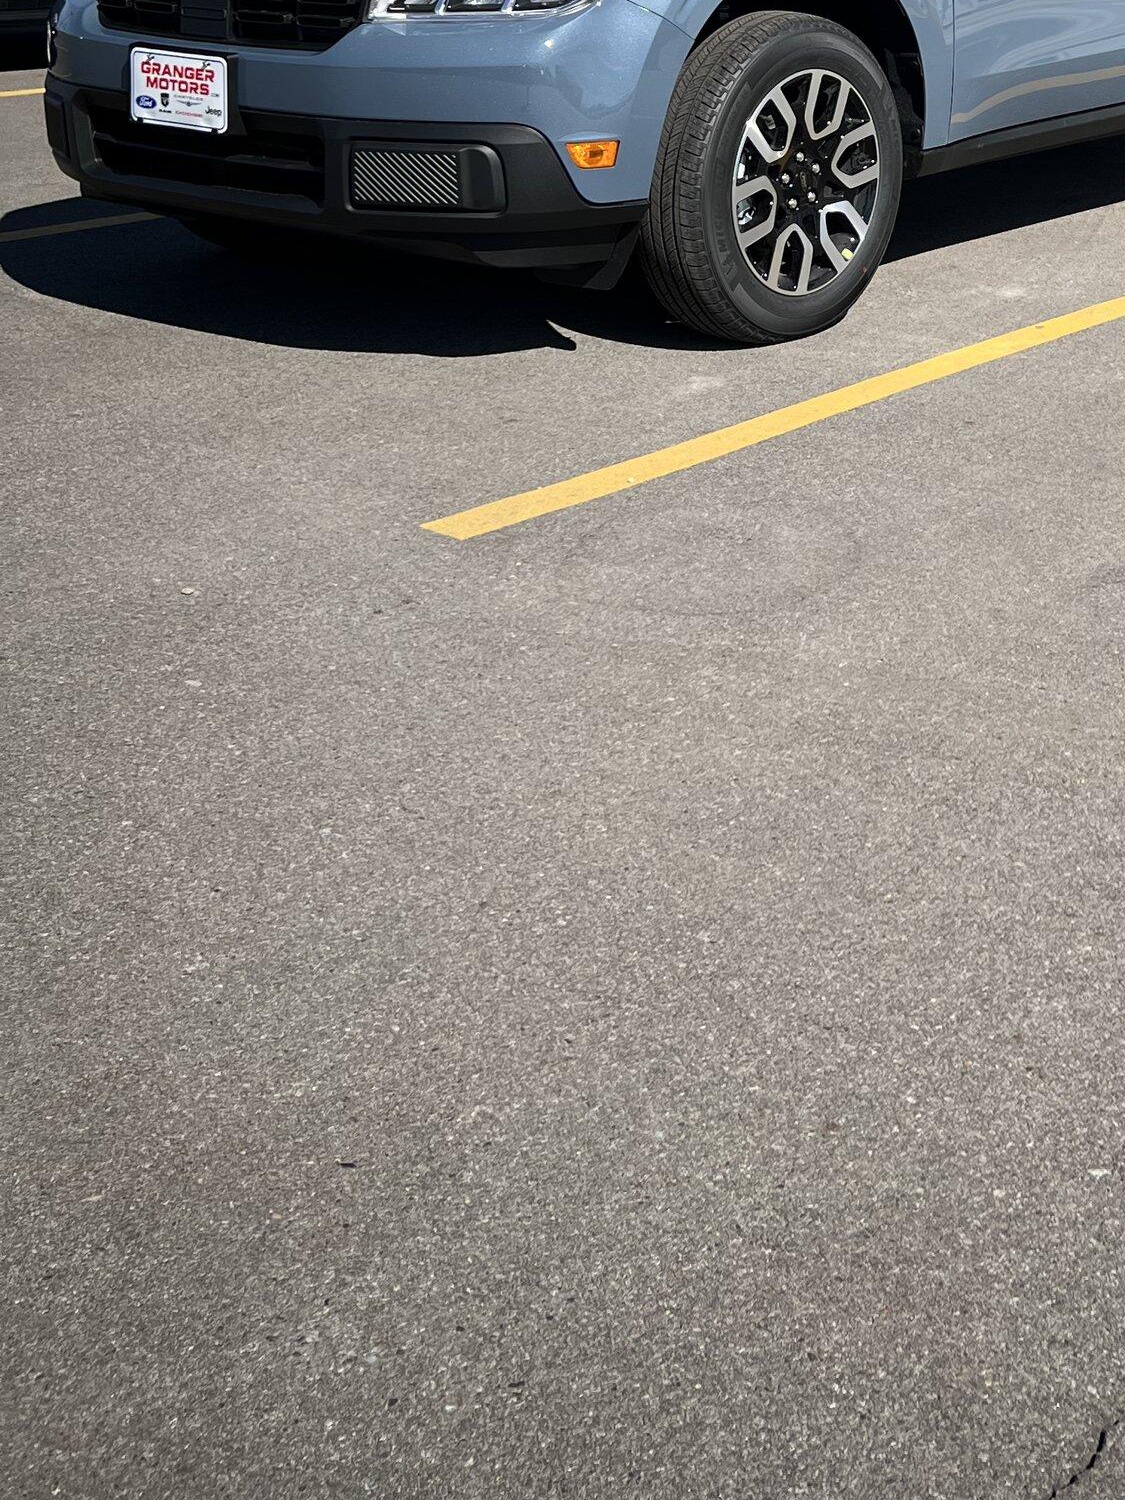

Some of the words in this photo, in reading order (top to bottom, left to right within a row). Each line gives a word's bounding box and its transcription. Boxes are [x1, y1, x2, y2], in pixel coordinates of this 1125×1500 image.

[141, 61, 215, 82] GRANGER
[146, 76, 210, 95] MOTORS
[204, 105, 222, 117] Jeep
